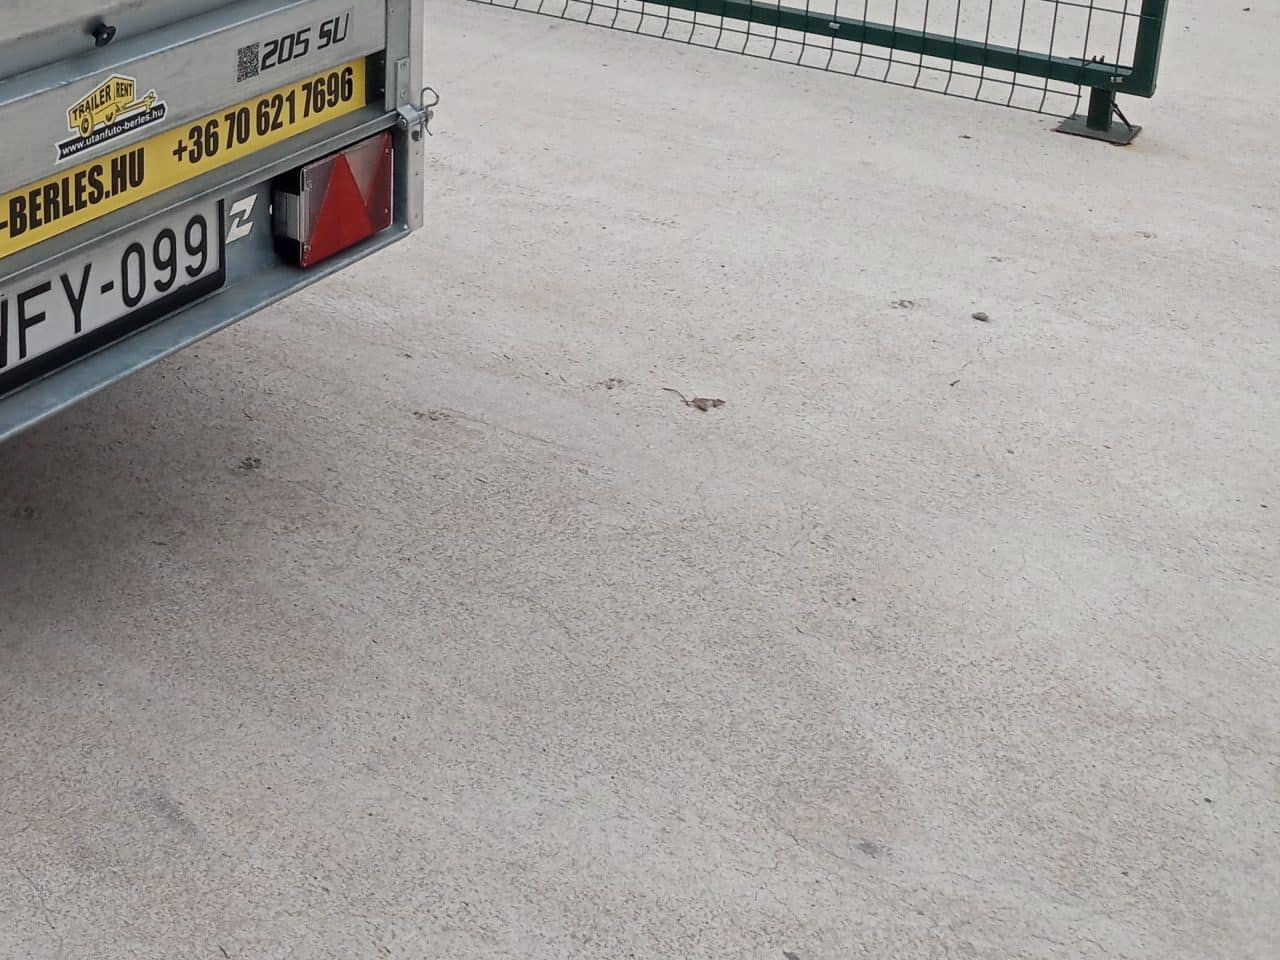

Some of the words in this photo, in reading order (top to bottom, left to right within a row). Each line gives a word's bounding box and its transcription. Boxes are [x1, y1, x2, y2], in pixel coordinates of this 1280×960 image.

[260, 27, 311, 72] 205
[317, 13, 350, 50] SU
[72, 84, 112, 121] TRAILER
[116, 81, 133, 98] RENT
[172, 118, 220, 164] +36
[224, 107, 250, 150] 70
[256, 89, 296, 137] 621
[301, 66, 354, 119] 7696
[61, 107, 165, 156] www.utanfuto-berles.hu
